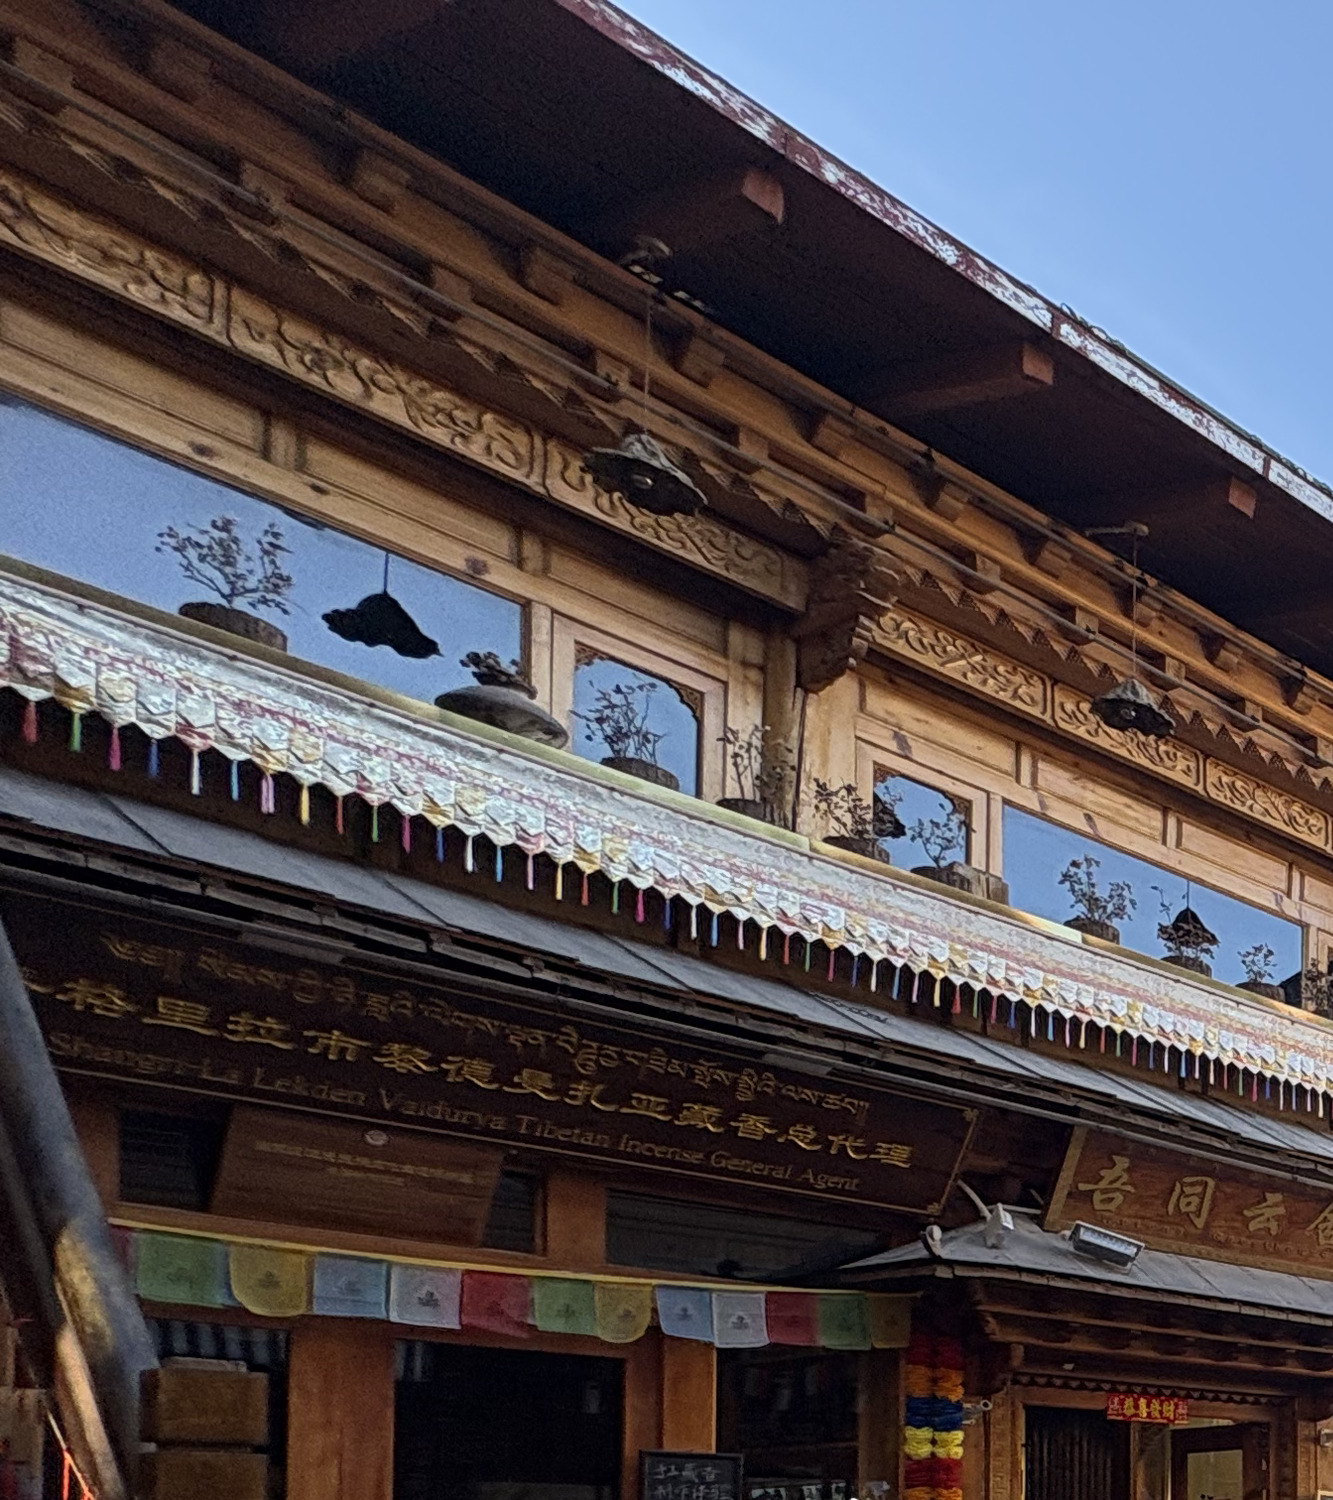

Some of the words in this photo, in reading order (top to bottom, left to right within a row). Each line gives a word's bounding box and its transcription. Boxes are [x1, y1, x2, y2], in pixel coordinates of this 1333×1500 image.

[515, 1112, 612, 1150] Tibetan
[616, 1132, 706, 1166] Incense
[799, 1166, 862, 1194] Agent
